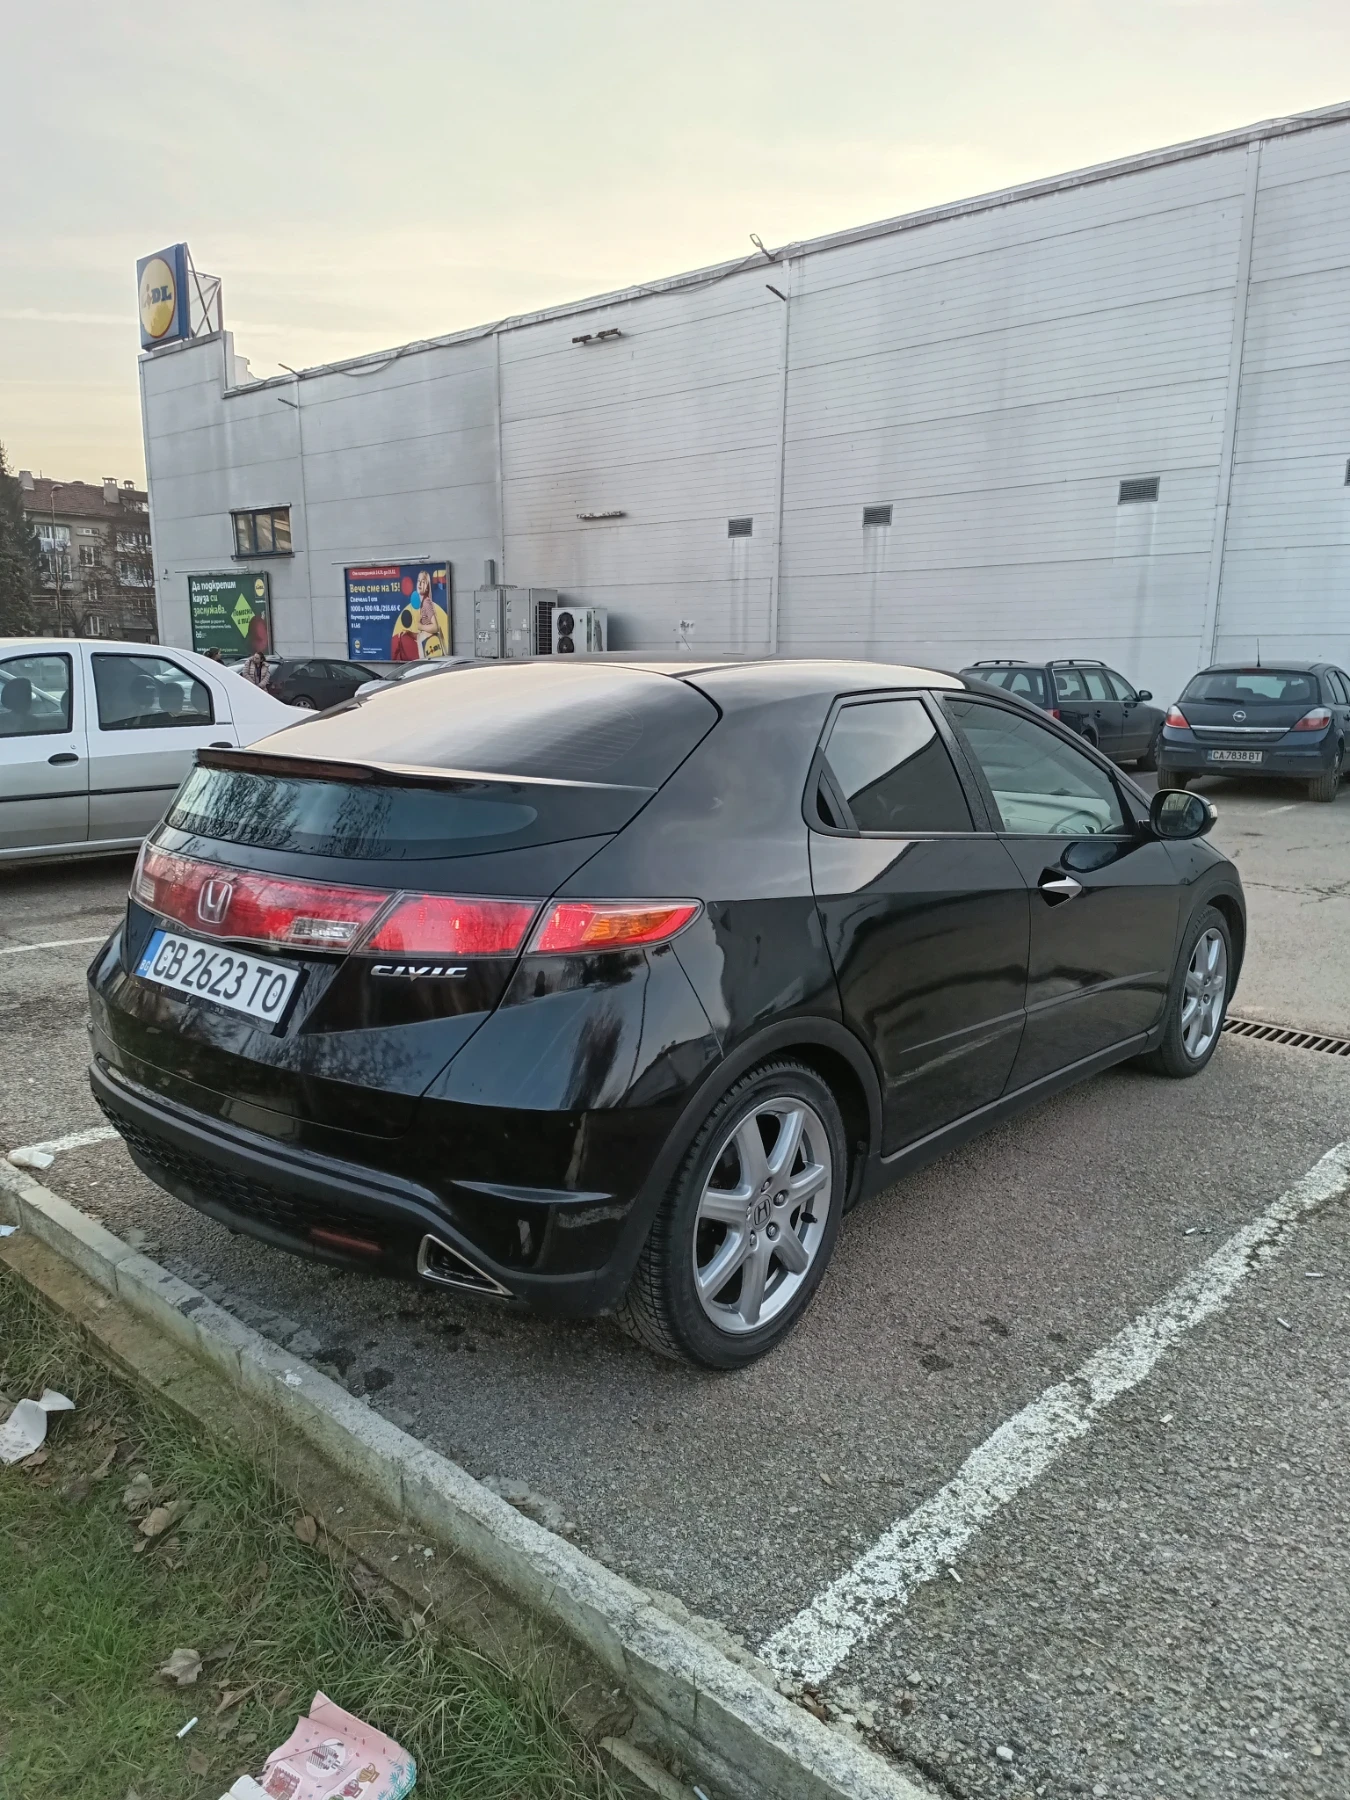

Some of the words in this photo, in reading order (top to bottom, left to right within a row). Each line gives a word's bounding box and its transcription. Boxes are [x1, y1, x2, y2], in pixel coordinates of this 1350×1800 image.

[192, 581, 201, 592] Да
[201, 580, 237, 592] подкрепим
[349, 584, 366, 593] Вече
[366, 585, 380, 593] сме
[381, 584, 390, 592] на
[390, 582, 400, 592] 15!
[192, 593, 210, 604] кауза
[210, 594, 218, 602] си
[1213, 751, 1225, 760] CA
[1225, 751, 1247, 760] 7838
[140, 959, 151, 971] BG
[153, 940, 188, 980] CB
[180, 948, 248, 1000] 2623
[247, 966, 287, 1013] TO
[370, 964, 468, 982] CIVIC
